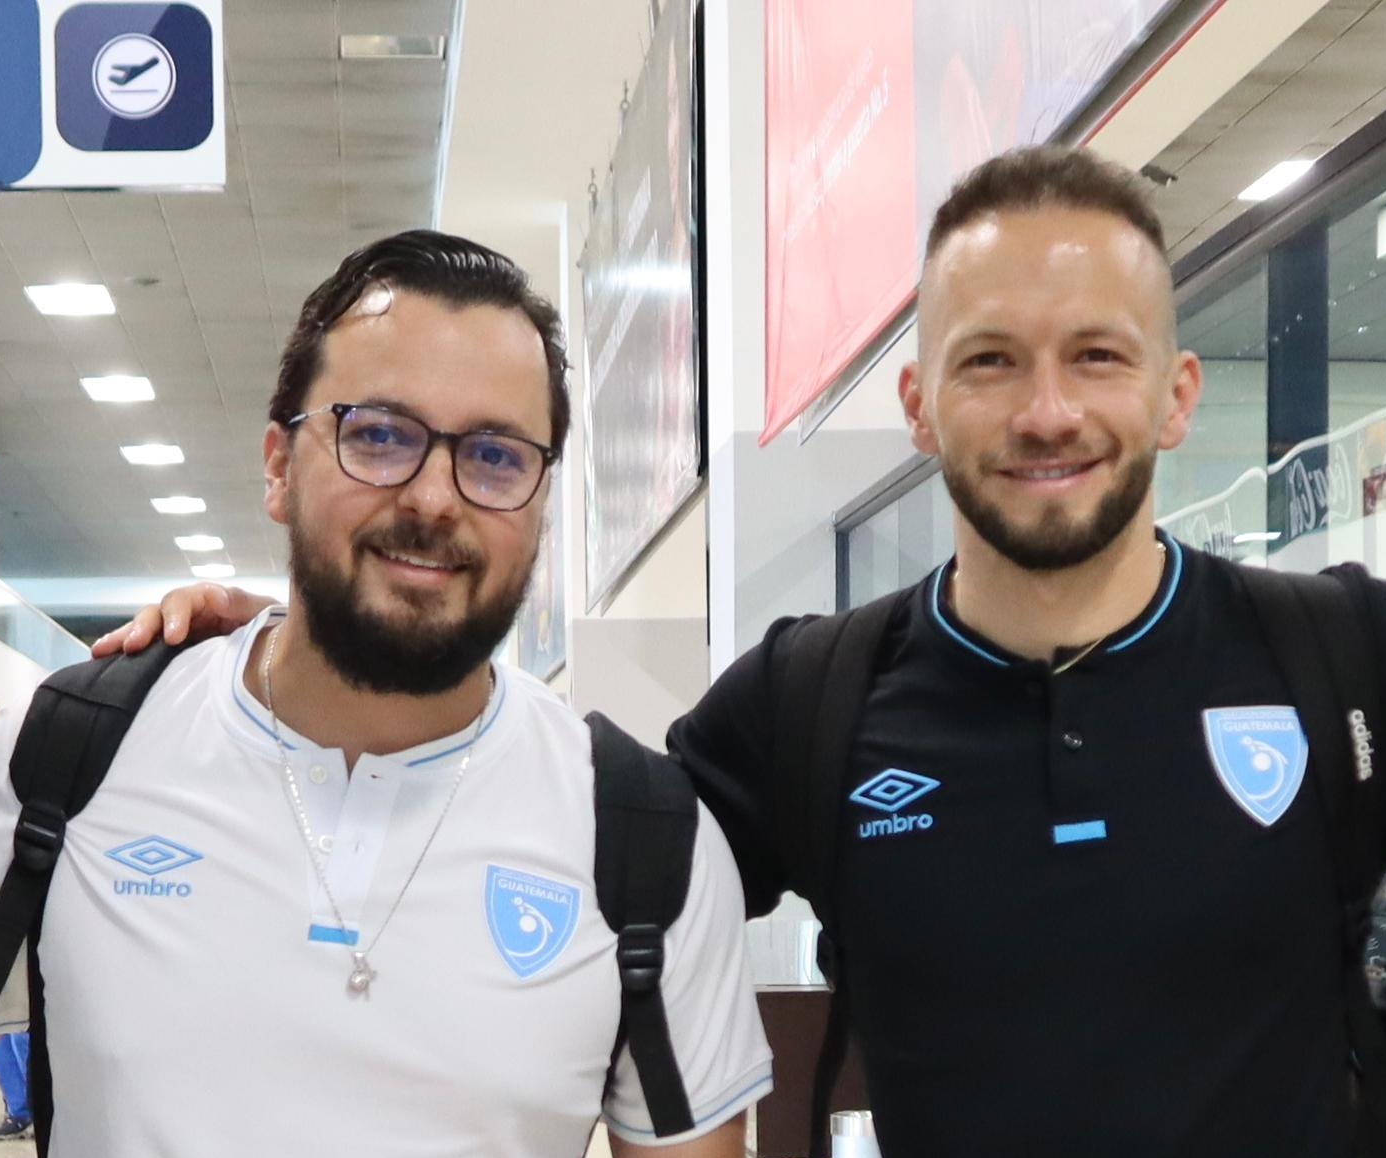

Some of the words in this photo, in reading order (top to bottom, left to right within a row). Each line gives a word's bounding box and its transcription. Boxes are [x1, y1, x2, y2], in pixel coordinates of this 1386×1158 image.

[1350, 708, 1374, 780] adidas
[859, 813, 934, 838] umbro
[113, 877, 192, 898] umbro
[498, 878, 570, 904] GUATEMALA
